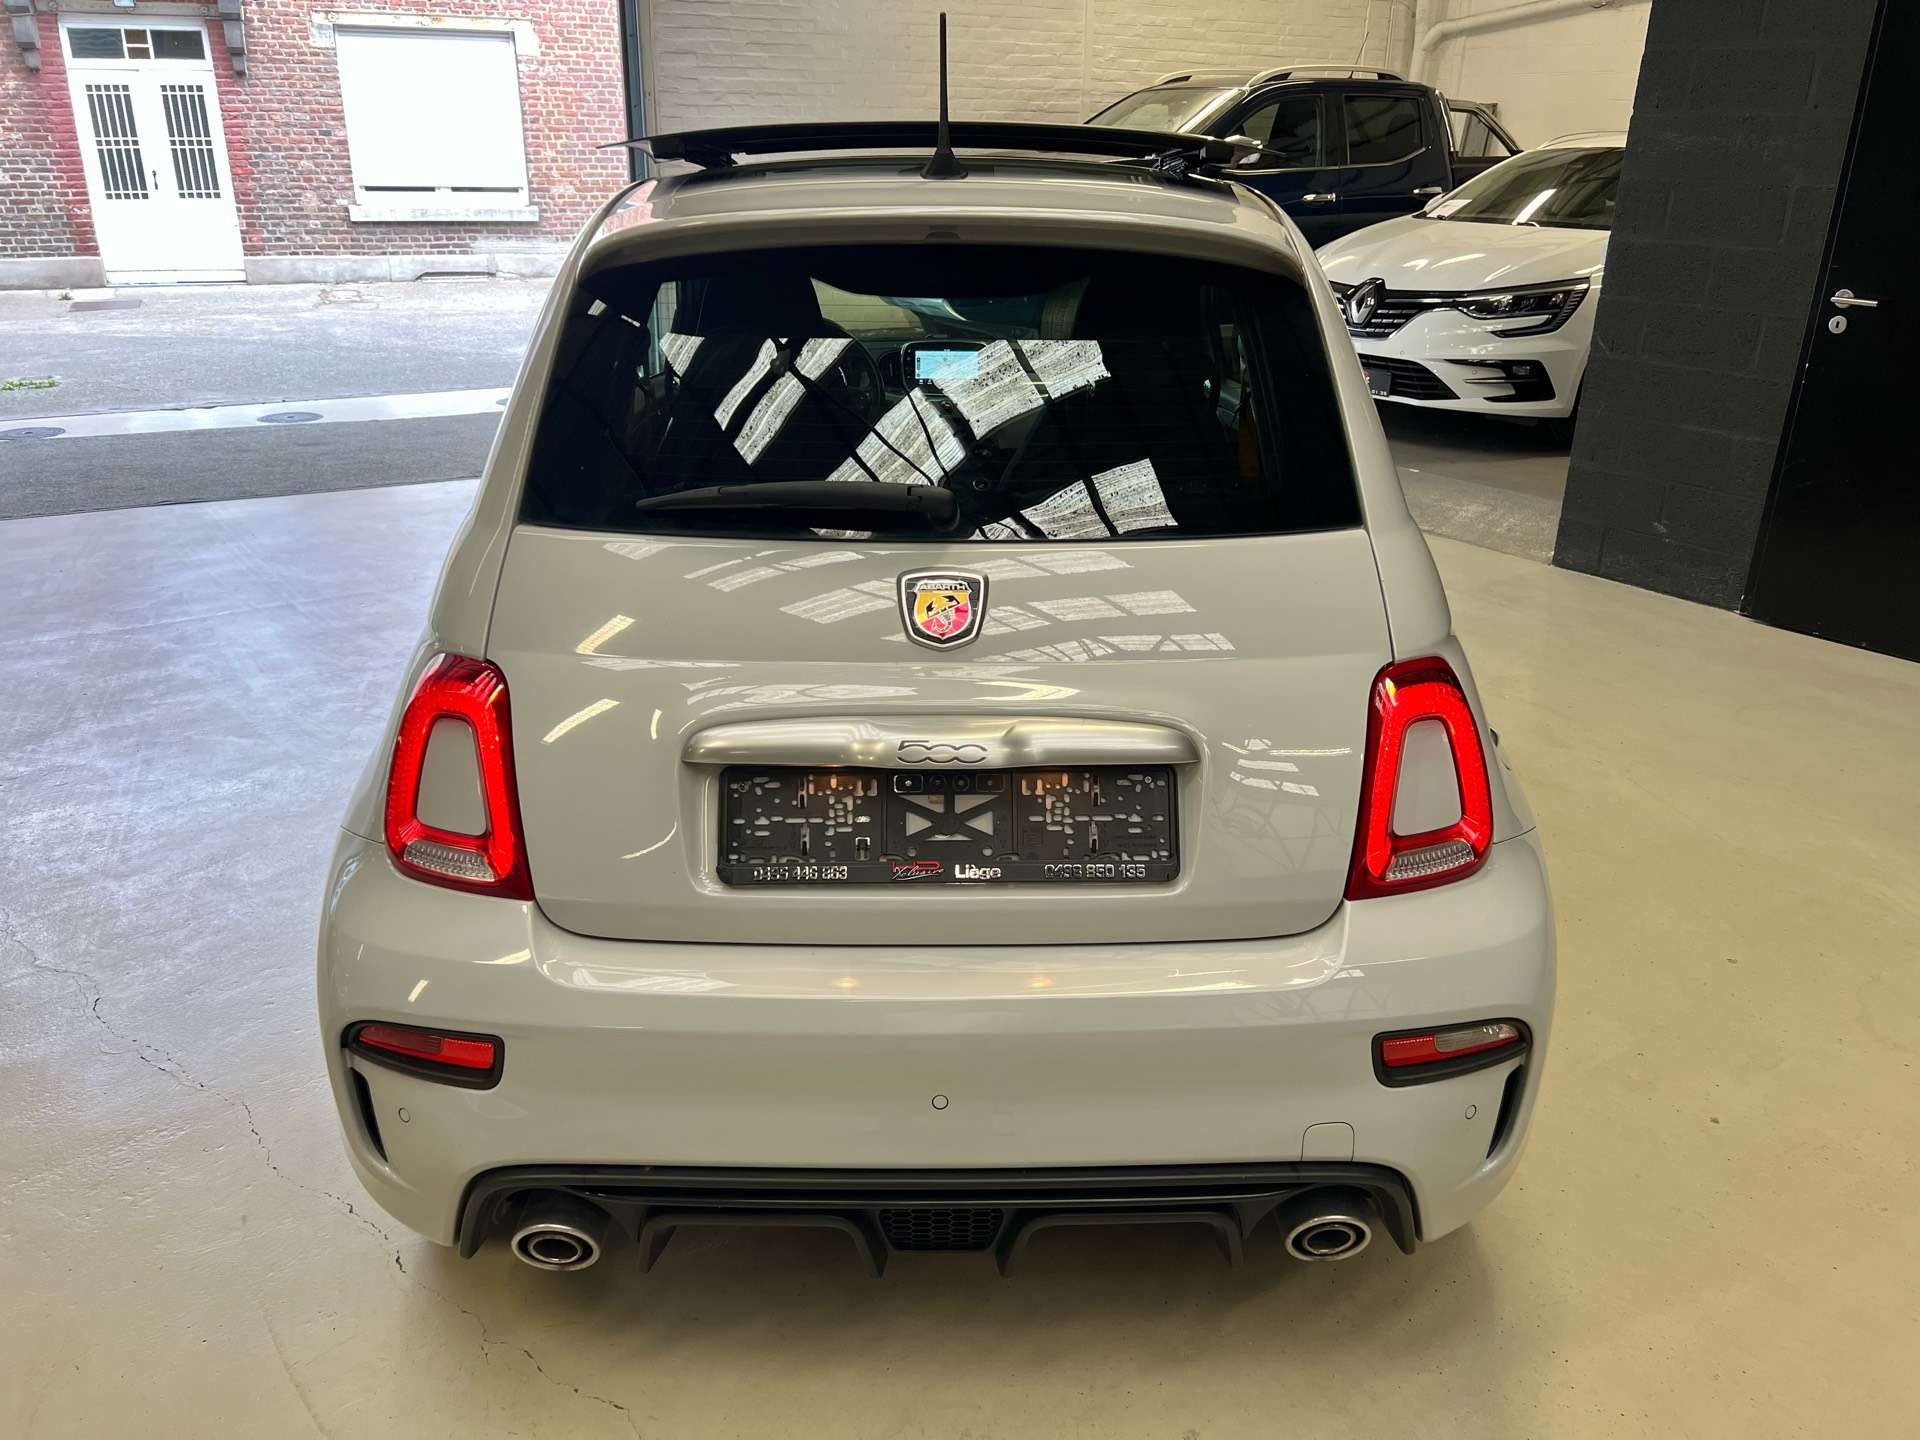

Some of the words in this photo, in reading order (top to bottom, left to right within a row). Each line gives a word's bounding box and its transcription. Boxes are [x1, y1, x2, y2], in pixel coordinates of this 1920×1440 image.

[919, 583, 967, 591] ABARTH
[896, 739, 988, 765] 500
[792, 866, 818, 880] 446
[954, 864, 1002, 880] Liège
[1086, 864, 1115, 878] 850
[1118, 864, 1146, 878] 135
